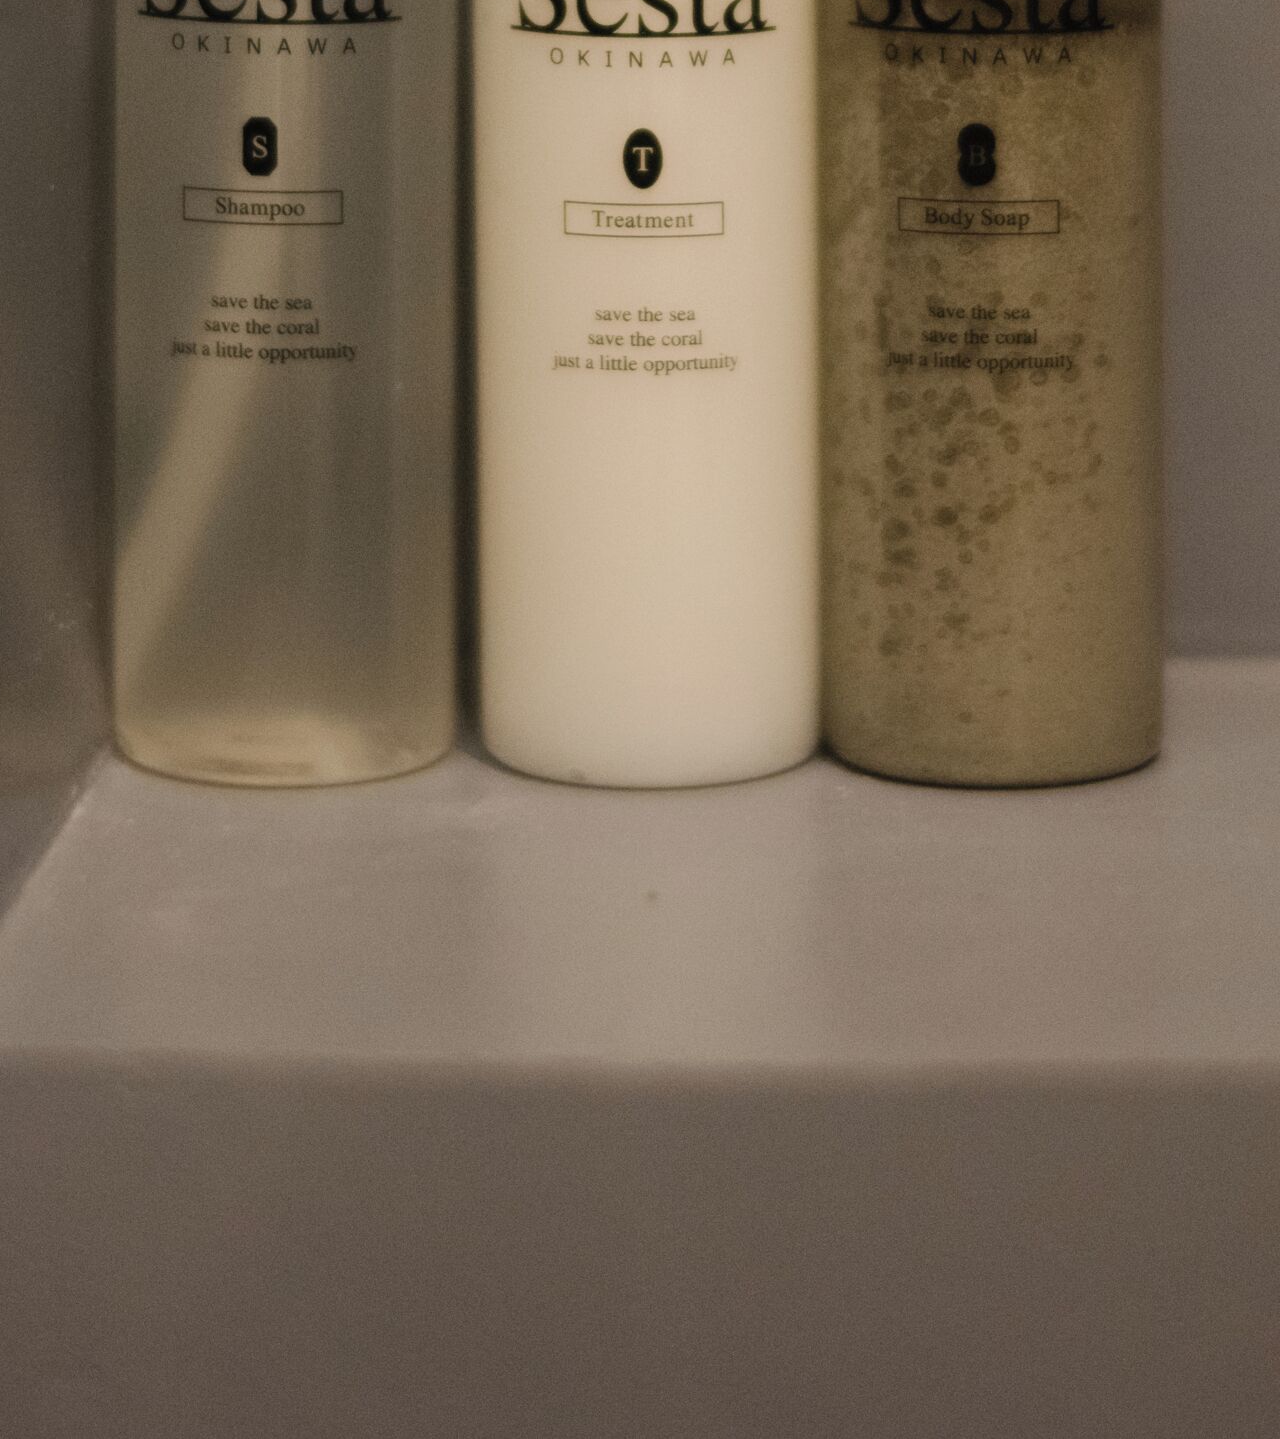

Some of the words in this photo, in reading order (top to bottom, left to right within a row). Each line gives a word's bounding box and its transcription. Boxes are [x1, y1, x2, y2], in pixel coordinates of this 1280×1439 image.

[171, 31, 358, 56] OKINAWA
[884, 42, 1074, 66] OKINAWA
[548, 46, 737, 69] OKINAWA
[251, 134, 269, 159] S
[968, 144, 987, 168] B
[632, 146, 654, 173] T
[214, 196, 307, 223] Shampoo
[591, 209, 695, 230] Treatment
[924, 206, 974, 230] Body
[979, 207, 1032, 231] Soap
[209, 294, 250, 311] save
[252, 293, 281, 311] the
[284, 296, 313, 311] sea
[927, 303, 966, 321] save
[970, 303, 998, 321] the
[1002, 305, 1032, 321] sea
[203, 318, 242, 334] save
[245, 318, 273, 336] the
[275, 318, 322, 336] coral
[593, 306, 633, 324] save
[637, 306, 664, 324] the
[668, 308, 697, 323] sea
[587, 330, 626, 347] save
[629, 329, 657, 348] the
[660, 329, 704, 348] coral
[920, 327, 960, 345] save
[963, 327, 991, 346] the
[994, 327, 1039, 346] coral
[170, 339, 198, 358] just
[201, 344, 212, 358] a
[214, 340, 254, 360] little
[257, 341, 359, 365] opportunity
[550, 352, 582, 371] just
[584, 357, 595, 370] a
[598, 353, 639, 373] little
[642, 352, 740, 376] opportunity
[885, 349, 916, 369] just
[919, 355, 930, 368] a
[932, 351, 973, 370] little
[976, 351, 1076, 374] opportunity
